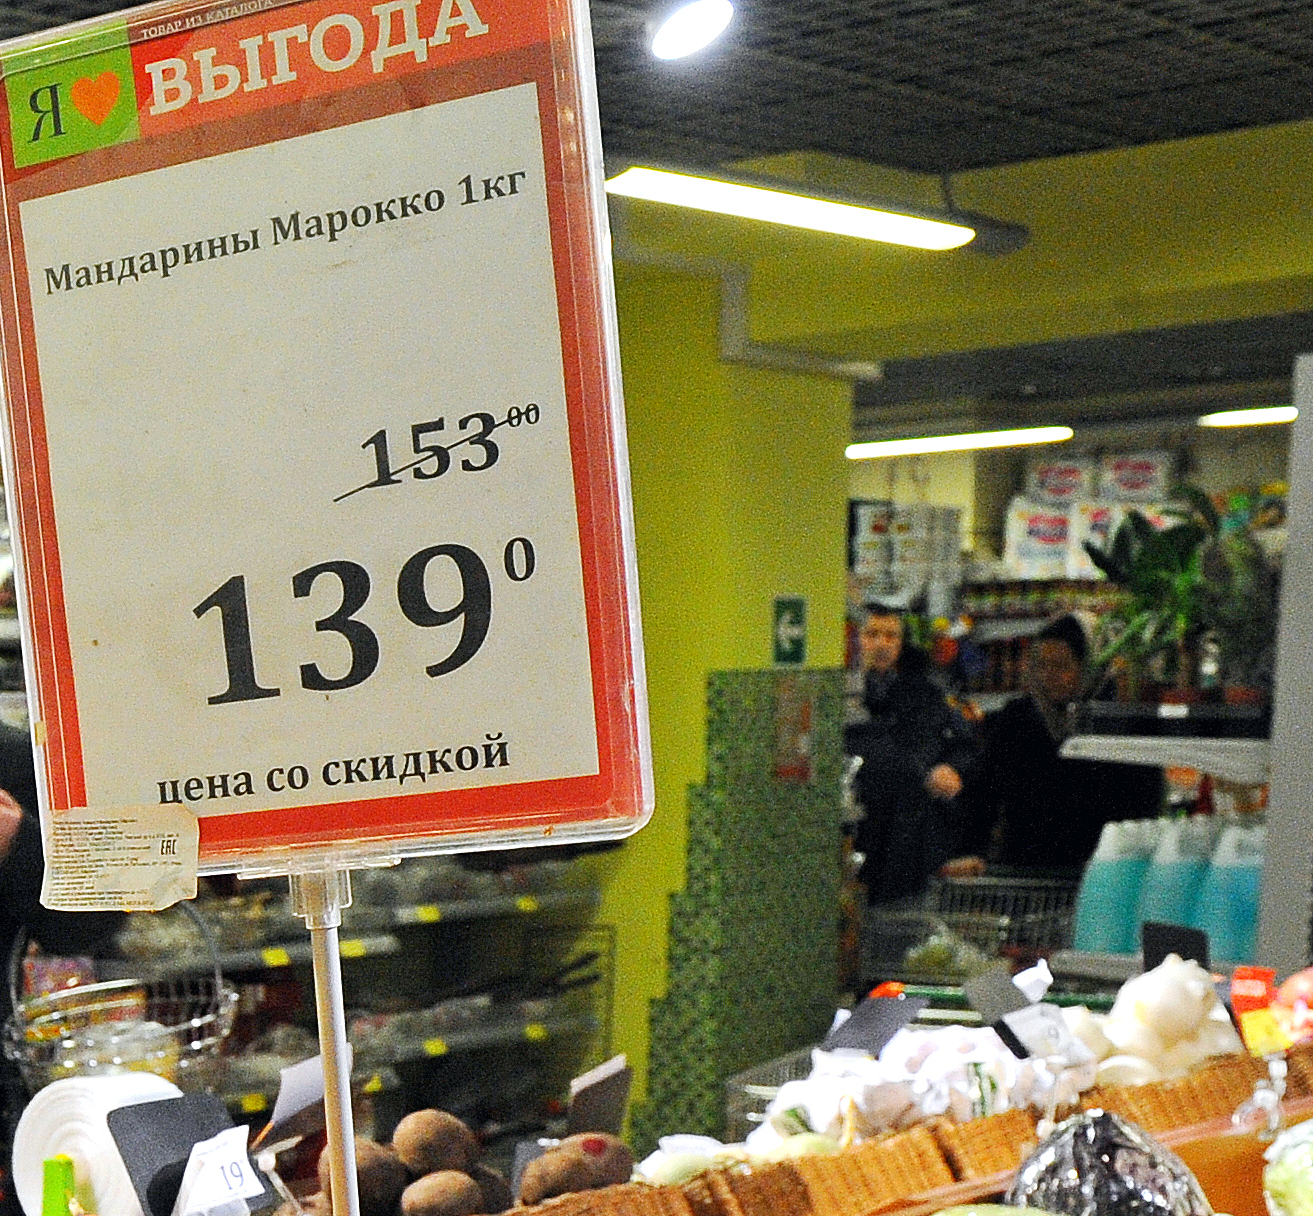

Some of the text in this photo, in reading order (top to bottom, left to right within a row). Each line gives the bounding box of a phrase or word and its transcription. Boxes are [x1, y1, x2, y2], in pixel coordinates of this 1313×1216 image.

[27, 0, 490, 143] Я ВЫГОДА
[141, 20, 182, 40] ТОВАР
[185, 16, 203, 29] ИЗ
[44, 170, 527, 295] Мандарины Марокко 1кг
[156, 732, 511, 804] цена со скидкой
